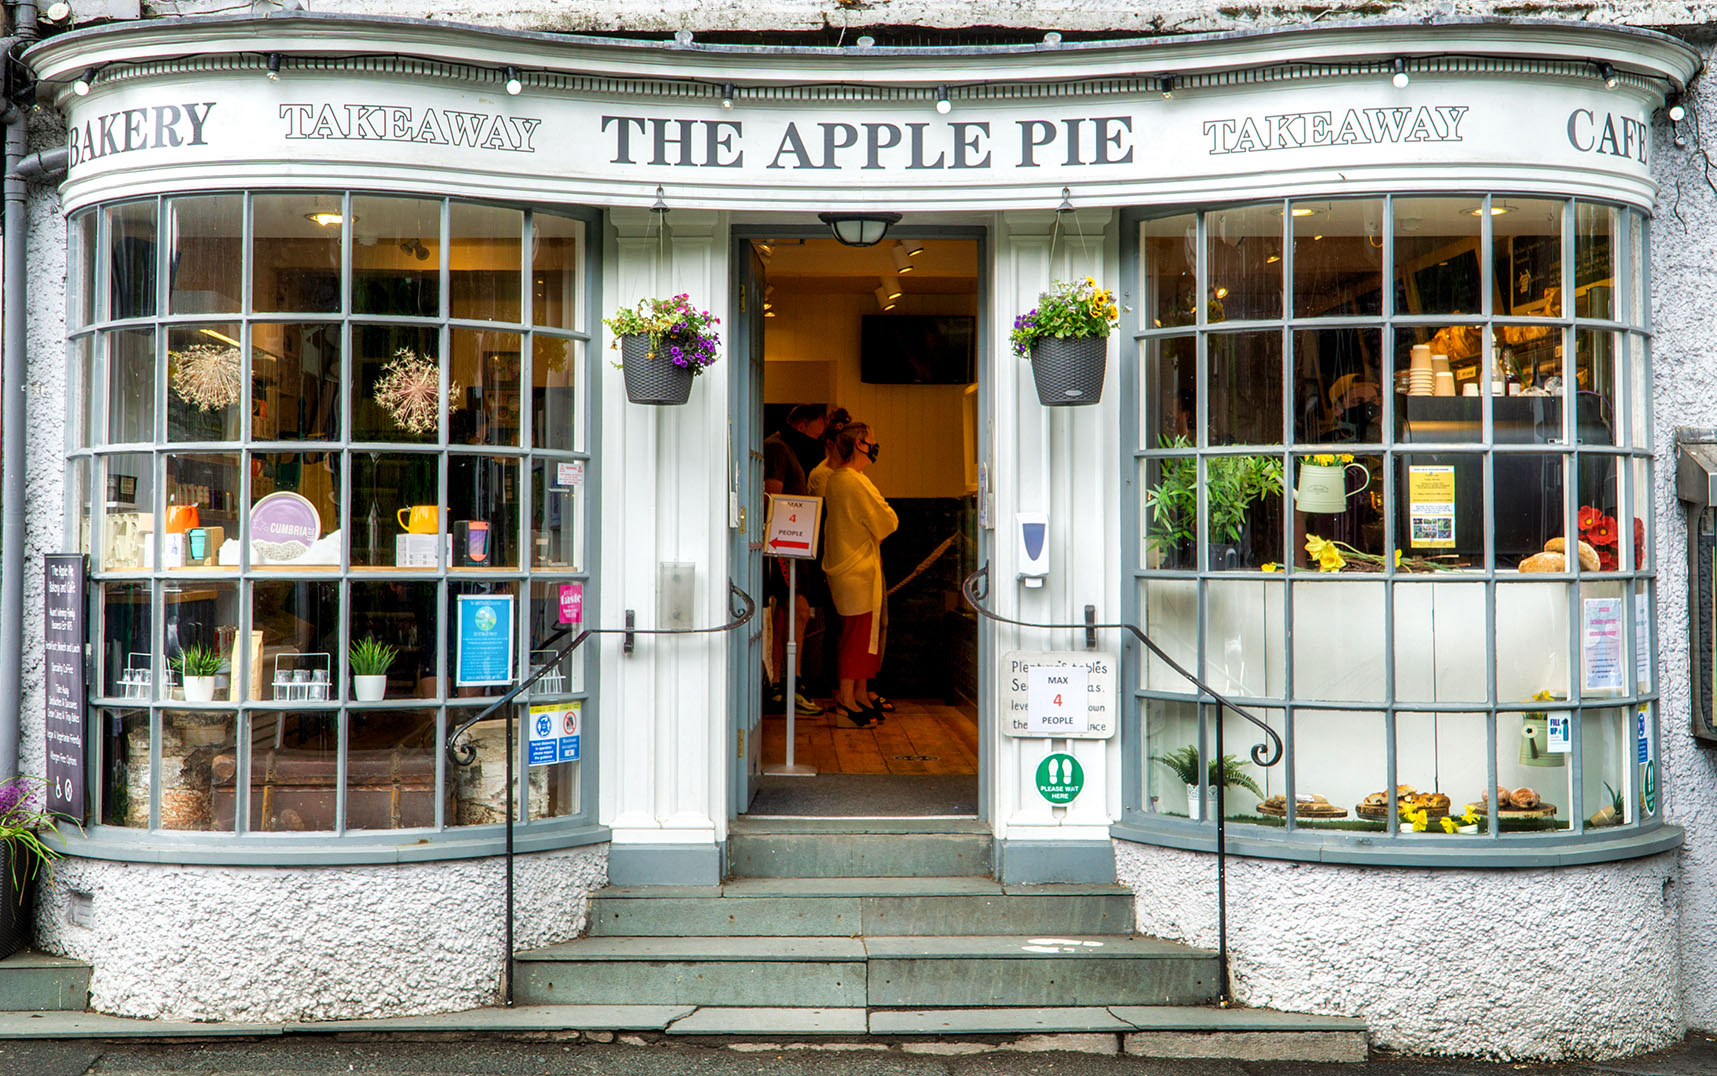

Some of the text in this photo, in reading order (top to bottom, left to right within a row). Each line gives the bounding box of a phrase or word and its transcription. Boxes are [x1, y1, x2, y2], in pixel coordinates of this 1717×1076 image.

[279, 103, 542, 152] TAKEAWAY
[1203, 105, 1469, 155] TAKEAWAY
[69, 102, 217, 170] BAKERY
[1566, 108, 1648, 166] CAFE
[601, 115, 1134, 170] THE APPLE PIE
[788, 513, 797, 523] 4
[270, 522, 308, 537] CUMBRIA
[778, 529, 803, 537] PEOPLE
[1047, 676, 1069, 684] MAX
[1053, 693, 1063, 707] 4
[1042, 716, 1074, 725] PEOPLE
[1550, 718, 1561, 727] FILL
[1550, 727, 1558, 735] UP
[1040, 785, 1064, 793] PLEASE
